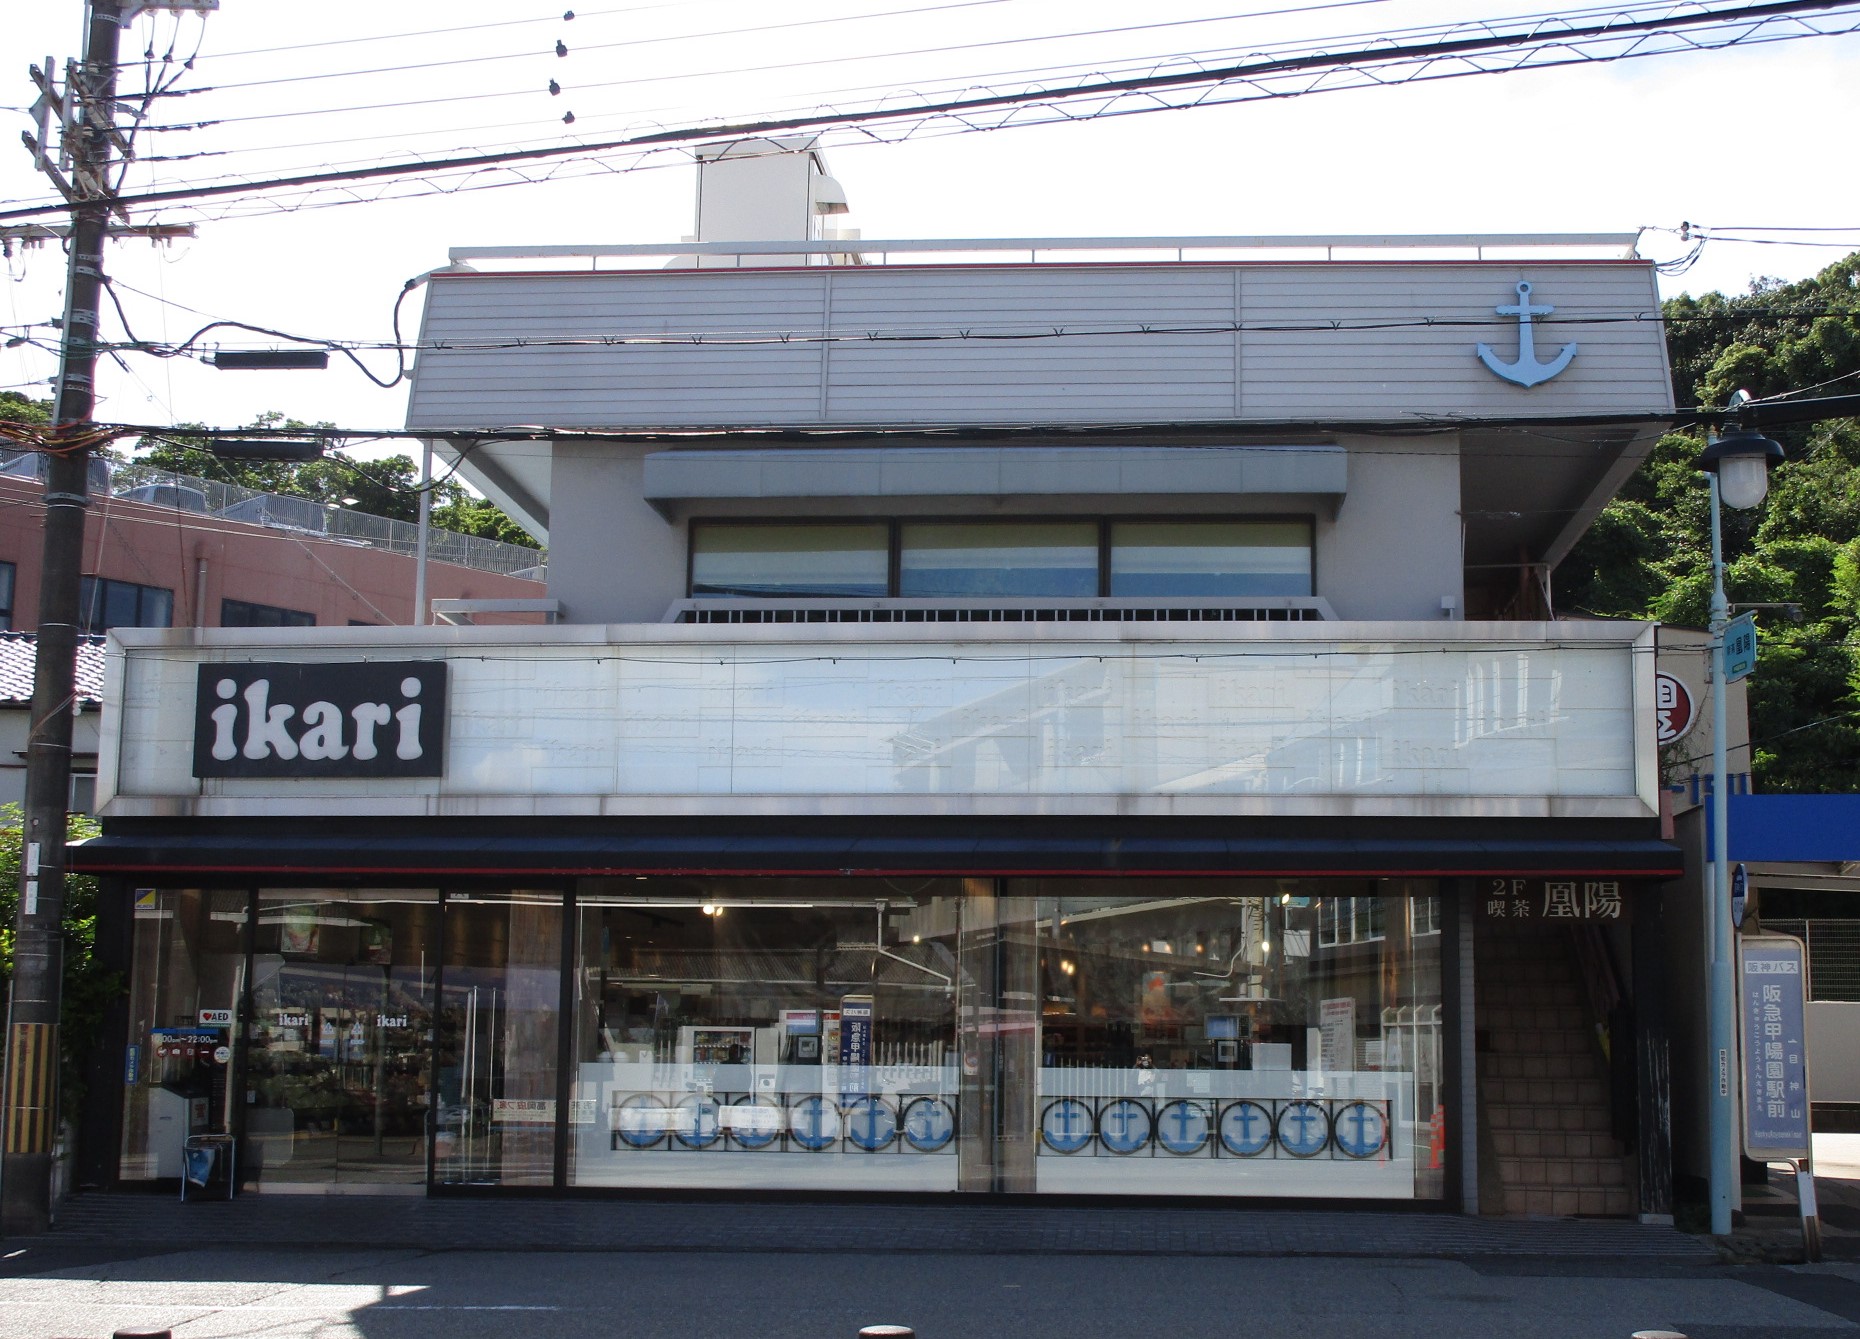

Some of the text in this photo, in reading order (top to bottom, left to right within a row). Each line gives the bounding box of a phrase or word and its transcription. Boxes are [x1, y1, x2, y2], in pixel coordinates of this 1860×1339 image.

[211, 677, 423, 760] ikari
[1492, 879, 1526, 895] 2F
[1542, 881, 1622, 918] 凰陽
[1487, 899, 1529, 917] 喫茶
[1747, 961, 1797, 973] 阪神バス
[211, 1012, 229, 1021] AED
[279, 1014, 309, 1026] ikari
[376, 1015, 407, 1027] ikari
[1763, 985, 1785, 1118] 阪急甲陽園駅前
